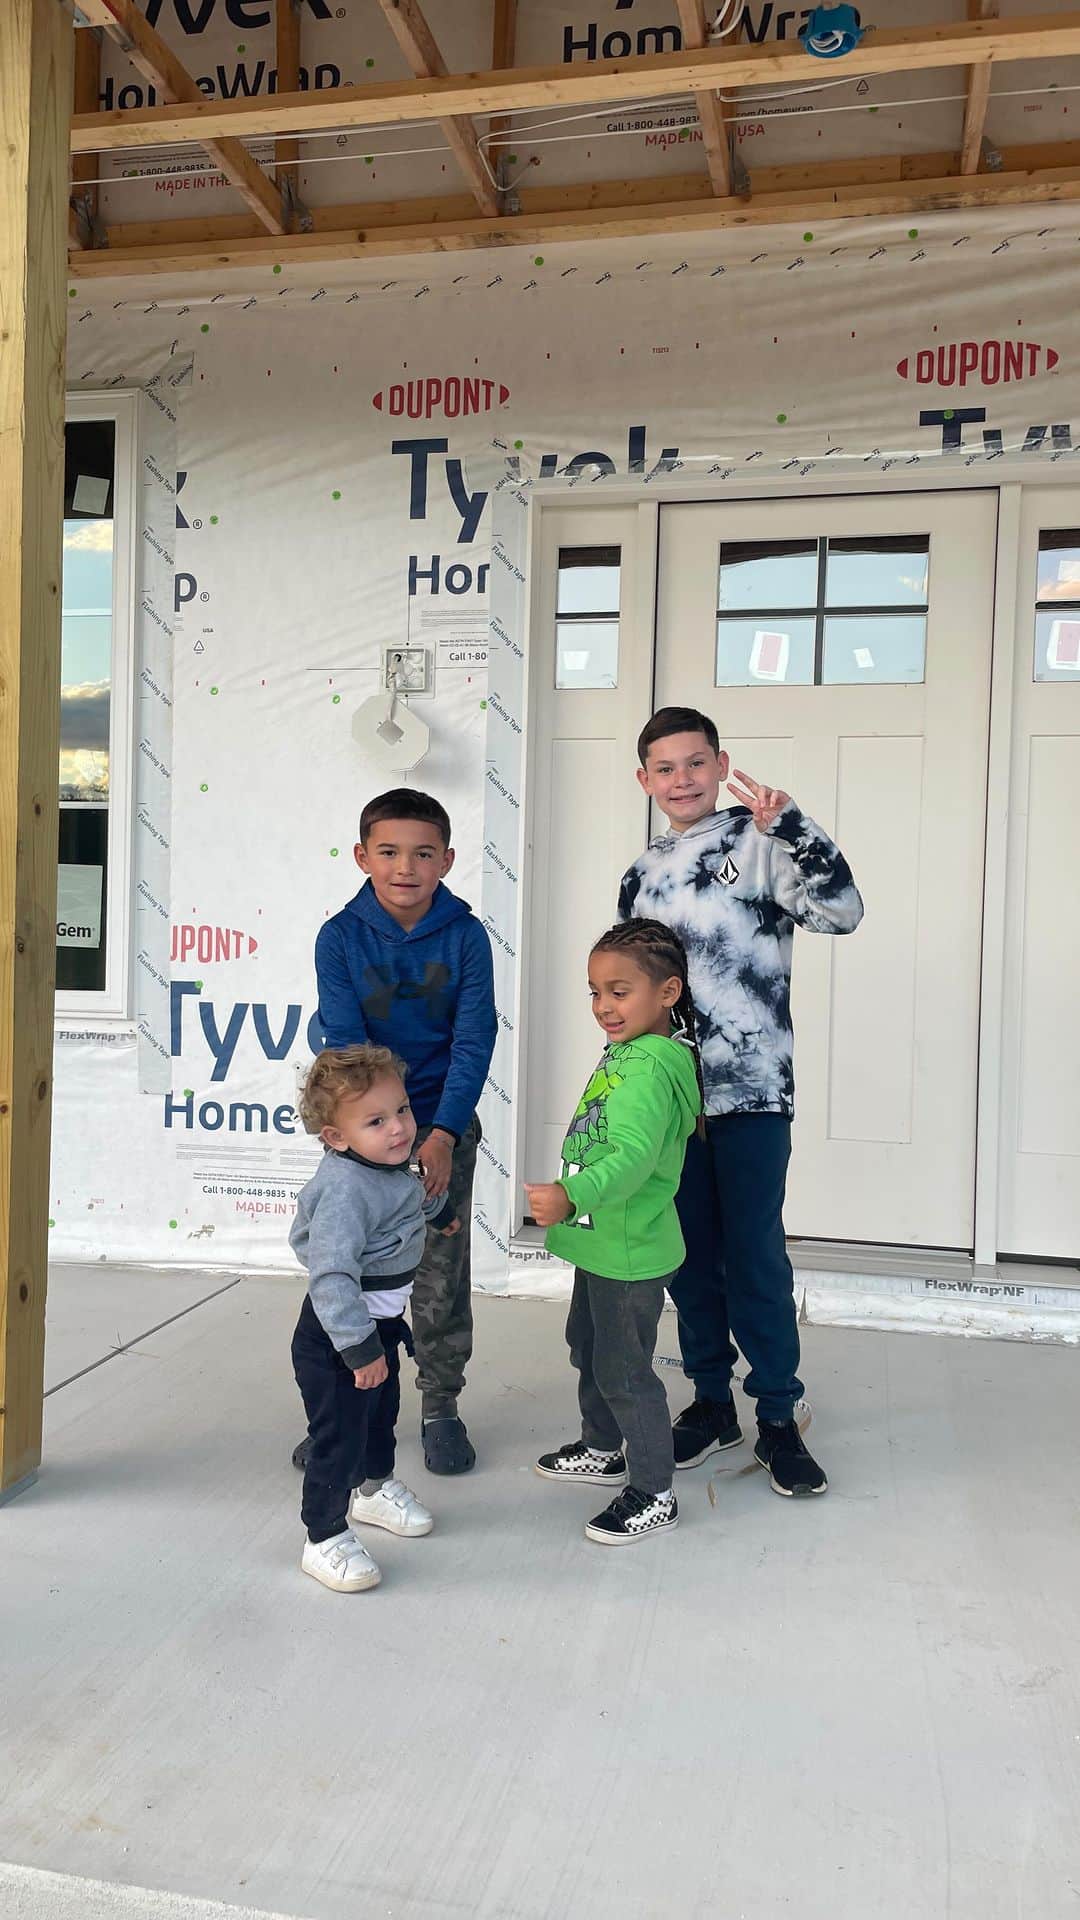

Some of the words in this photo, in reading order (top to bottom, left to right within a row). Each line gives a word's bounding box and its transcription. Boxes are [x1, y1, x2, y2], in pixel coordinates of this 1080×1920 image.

[607, 122, 624, 133] Call
[627, 116, 699, 131] 1-800-448-983
[645, 132, 684, 147] MADE
[738, 124, 765, 137] USA
[155, 179, 190, 191] MADE
[193, 177, 205, 189] IN
[916, 340, 1042, 386] DUPONT
[389, 376, 495, 419] DUPONT
[515, 490, 529, 507] Tape
[492, 545, 514, 572] Flashing
[513, 566, 526, 583] Tape
[490, 620, 512, 646] Flashing
[510, 641, 524, 658] Tape
[449, 651, 466, 661] Call
[488, 696, 510, 722] Flashing
[508, 718, 522, 734] Tape
[486, 770, 508, 797] Flashing
[506, 792, 520, 809] Tape
[484, 845, 506, 871] Flashing
[504, 866, 518, 883] Tape
[482, 919, 504, 945] Flashing
[502, 940, 516, 958] Tape
[501, 1014, 515, 1032] Tape
[498, 1088, 512, 1105] Tape
[497, 1162, 511, 1178] Tape
[202, 1184, 218, 1195] Call
[220, 1186, 287, 1198] 1-800-448-9835
[235, 1201, 271, 1214] MADE
[274, 1203, 287, 1215] IN
[474, 1214, 496, 1241] Flashing
[496, 1236, 508, 1253] Tape
[924, 1279, 999, 1297] FlexWrap
[1003, 1286, 1025, 1297] NF
